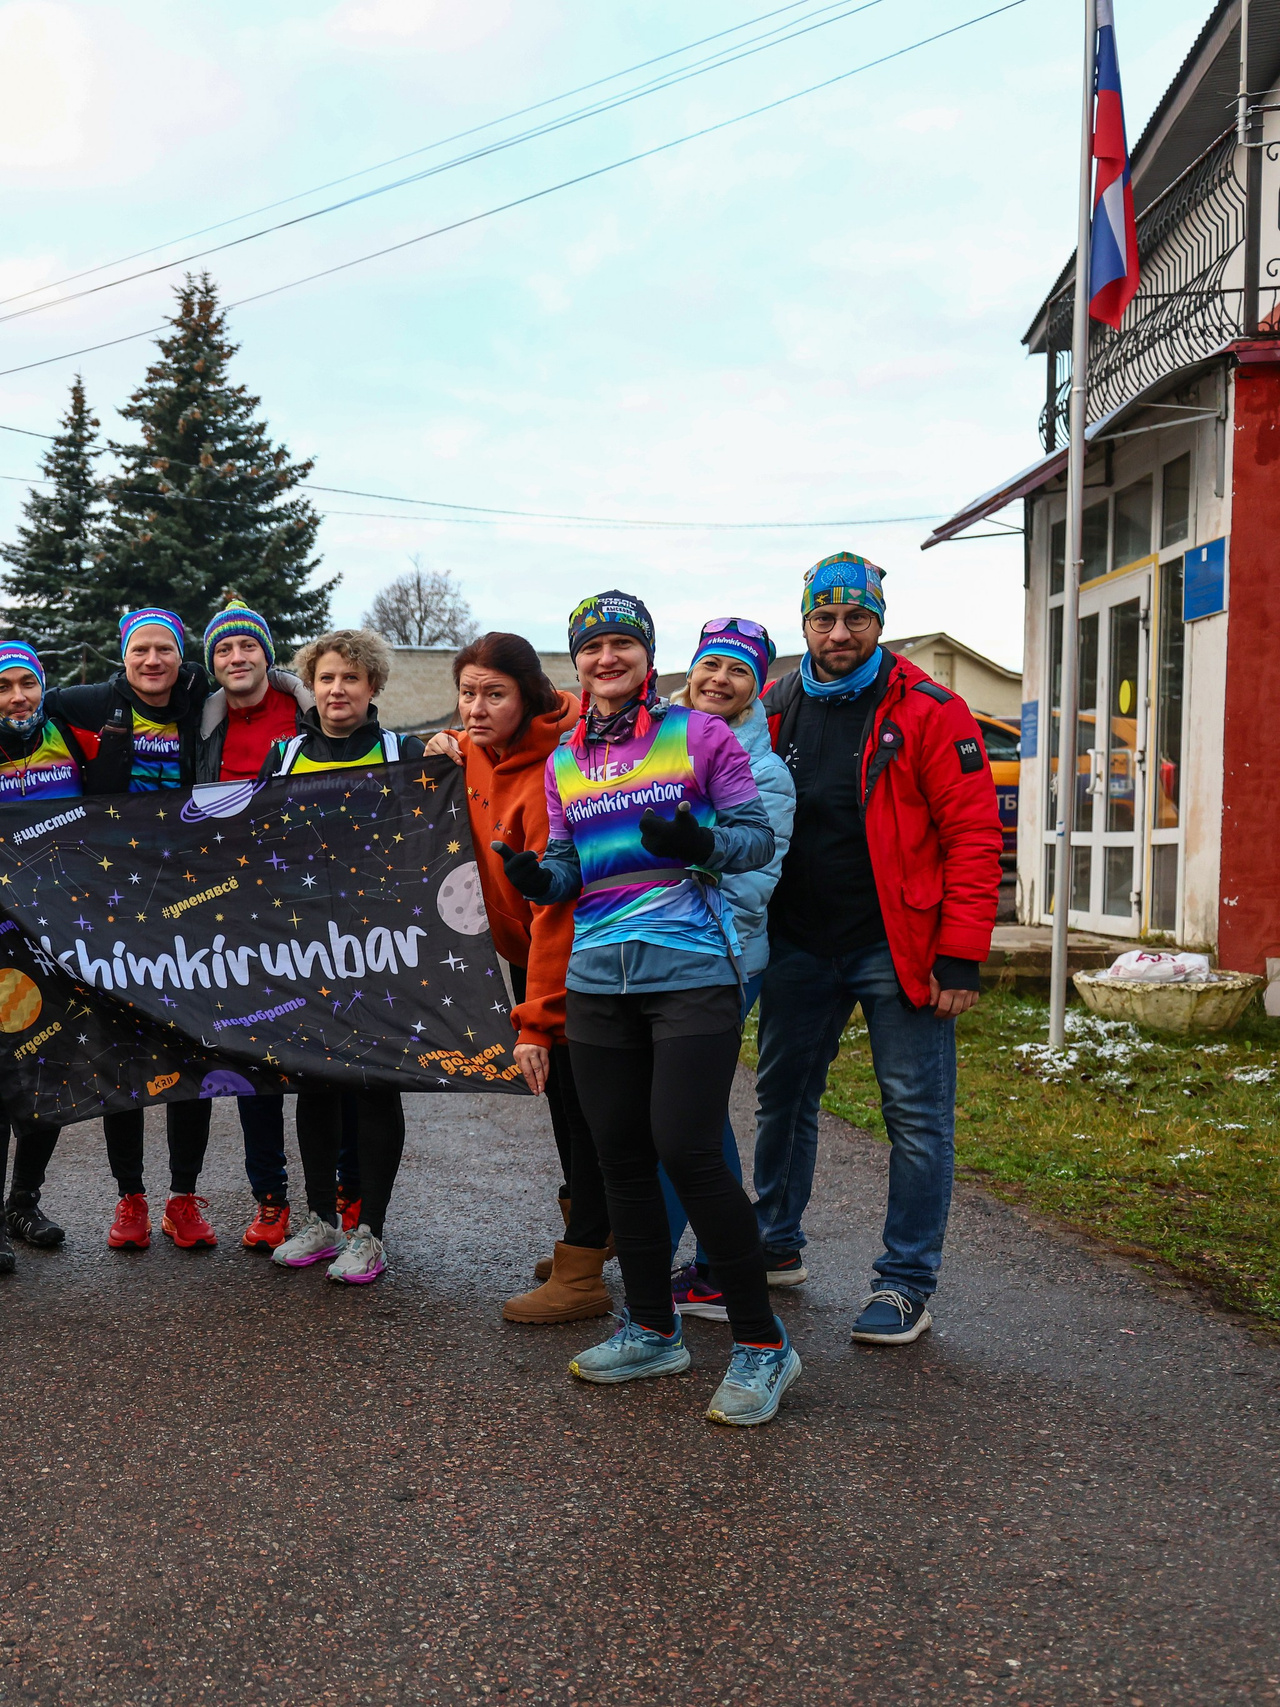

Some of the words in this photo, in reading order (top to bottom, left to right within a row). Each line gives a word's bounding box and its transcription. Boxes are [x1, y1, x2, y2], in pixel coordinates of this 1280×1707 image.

[960, 743, 977, 755] HH
[566, 783, 685, 824] #khimkirunbar
[12, 805, 87, 846] #щастак
[161, 875, 240, 920] #уменявсё
[213, 996, 307, 1032] #надобрать
[13, 1021, 63, 1061] #гдевсе
